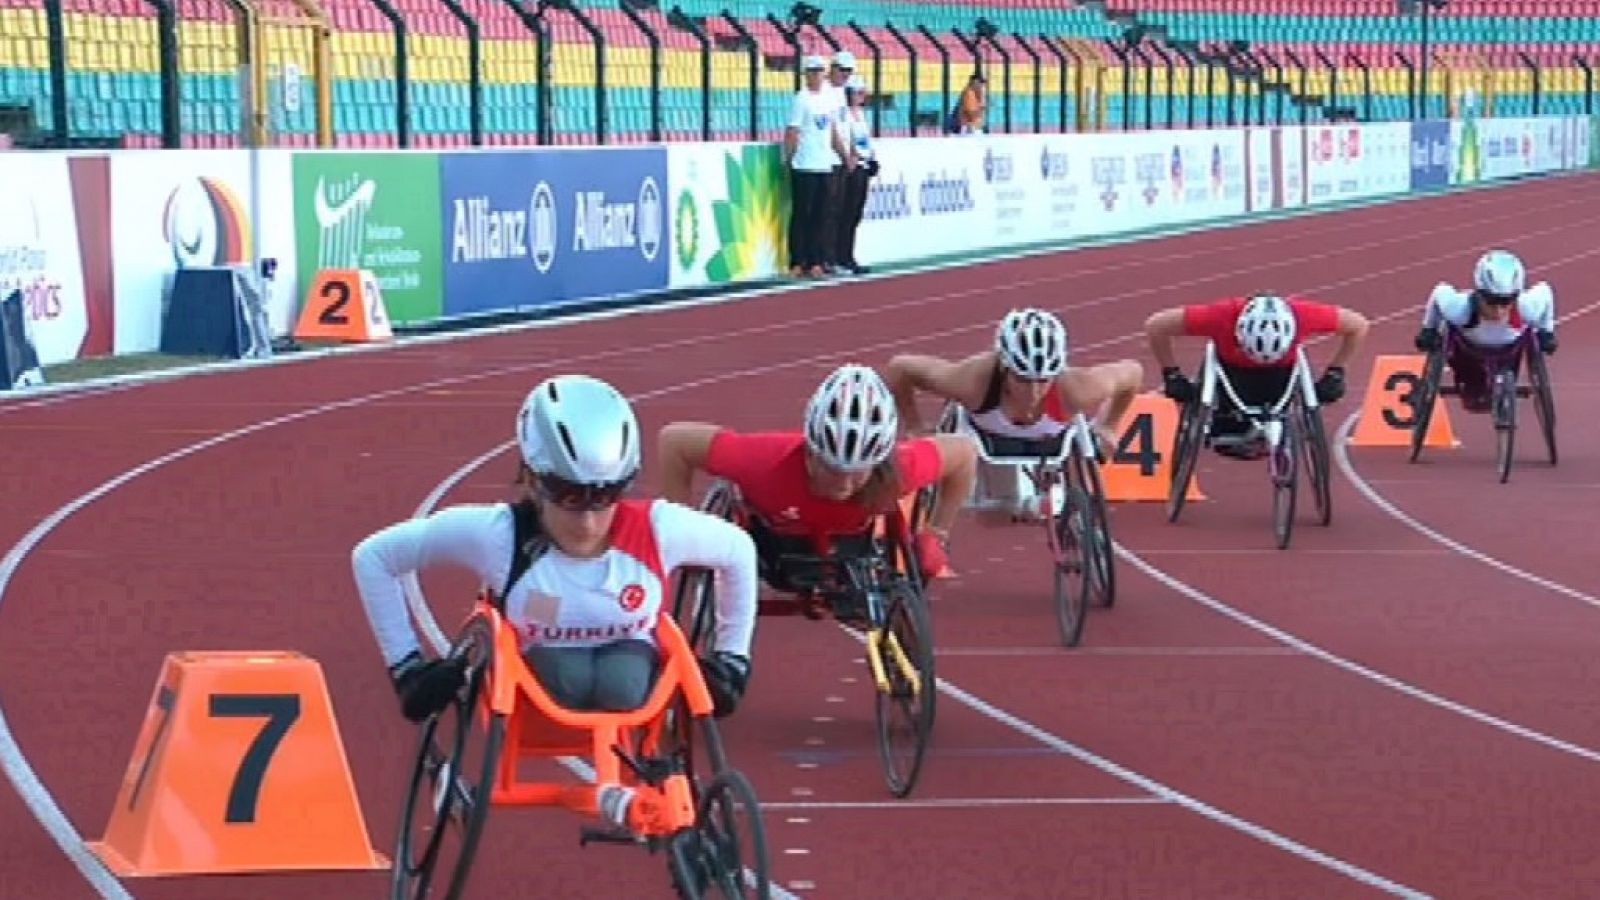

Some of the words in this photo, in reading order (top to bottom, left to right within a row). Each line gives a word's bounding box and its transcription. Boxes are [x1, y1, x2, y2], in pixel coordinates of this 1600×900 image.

[453, 196, 526, 263] Allianz
[574, 191, 637, 252] Allianz
[318, 280, 351, 325] 2
[1382, 371, 1420, 429] 3
[1113, 413, 1162, 476] 4
[208, 693, 301, 823] 7
